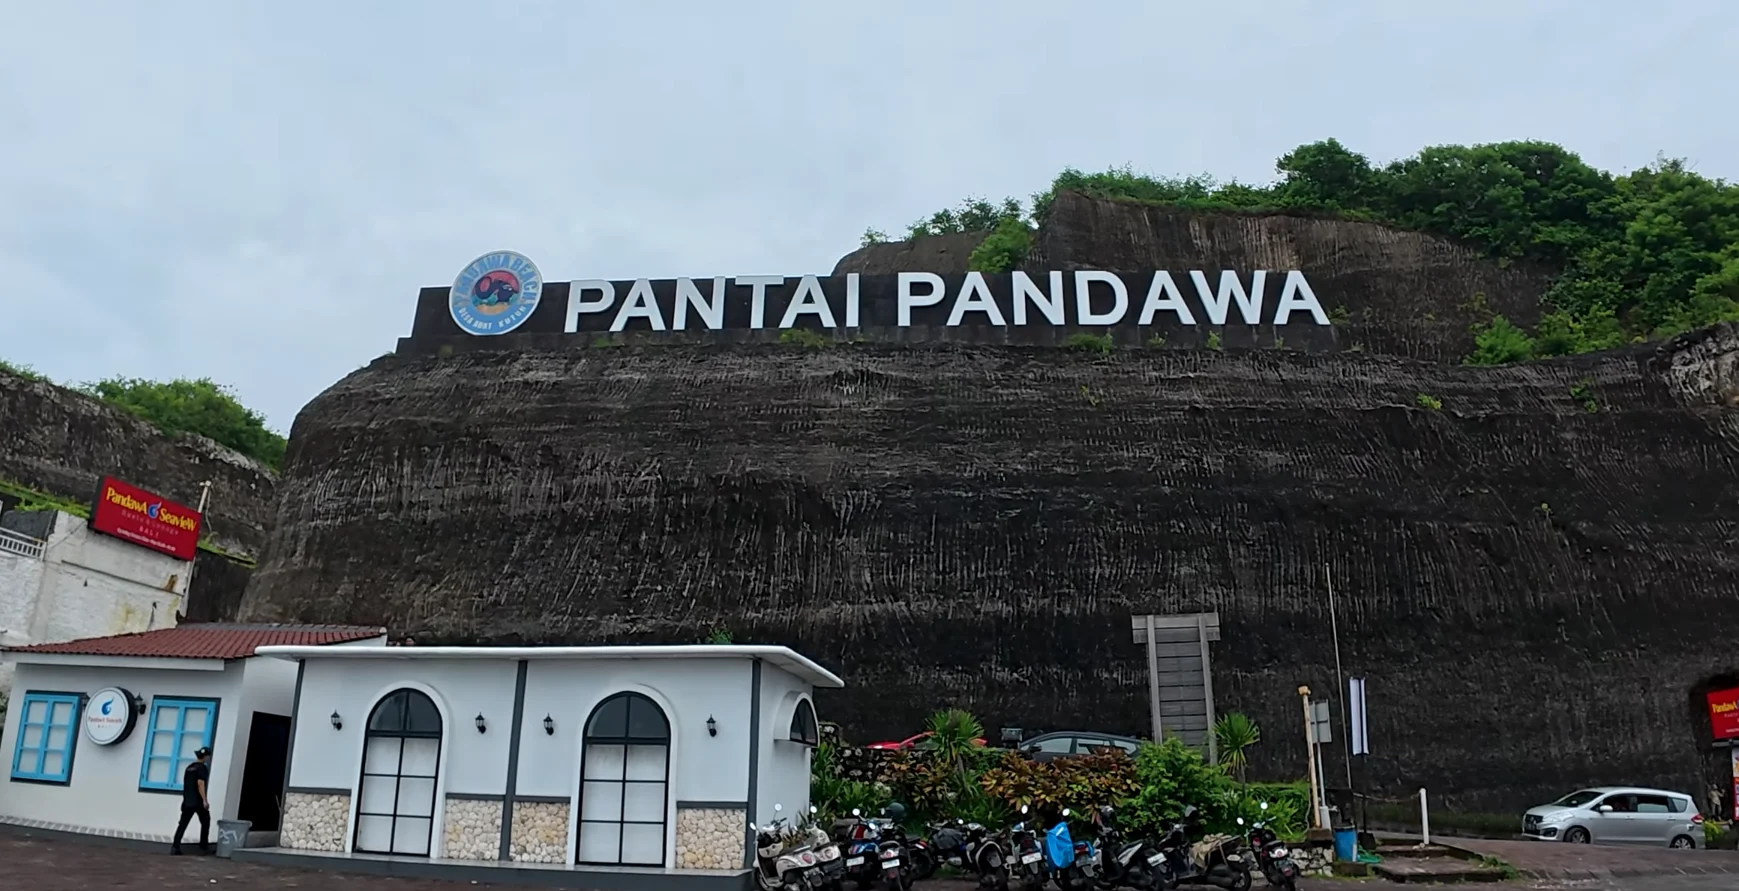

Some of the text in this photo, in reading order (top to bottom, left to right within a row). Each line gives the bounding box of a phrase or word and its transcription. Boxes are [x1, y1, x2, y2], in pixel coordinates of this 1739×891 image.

[458, 307, 474, 325] DESA
[472, 320, 493, 331] ADAT
[564, 269, 1331, 333] PANTAI PANDAWA
